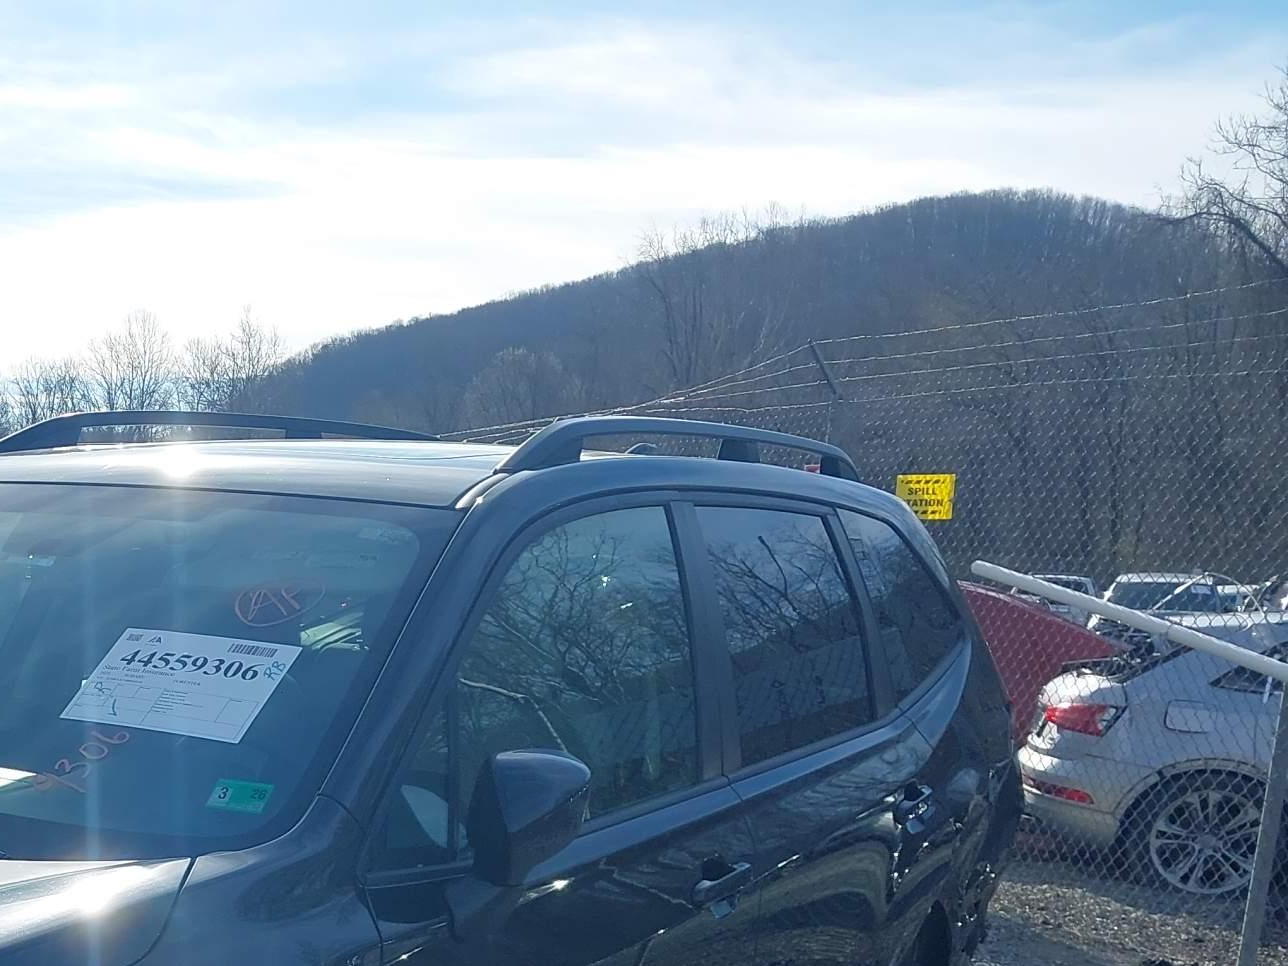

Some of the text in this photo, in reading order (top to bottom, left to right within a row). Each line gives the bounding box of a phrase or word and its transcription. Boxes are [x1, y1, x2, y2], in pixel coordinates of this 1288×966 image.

[907, 487, 937, 496] SPILL
[902, 498, 944, 507] TATION
[119, 649, 265, 681] 44559306
[218, 786, 268, 801] 3 26
